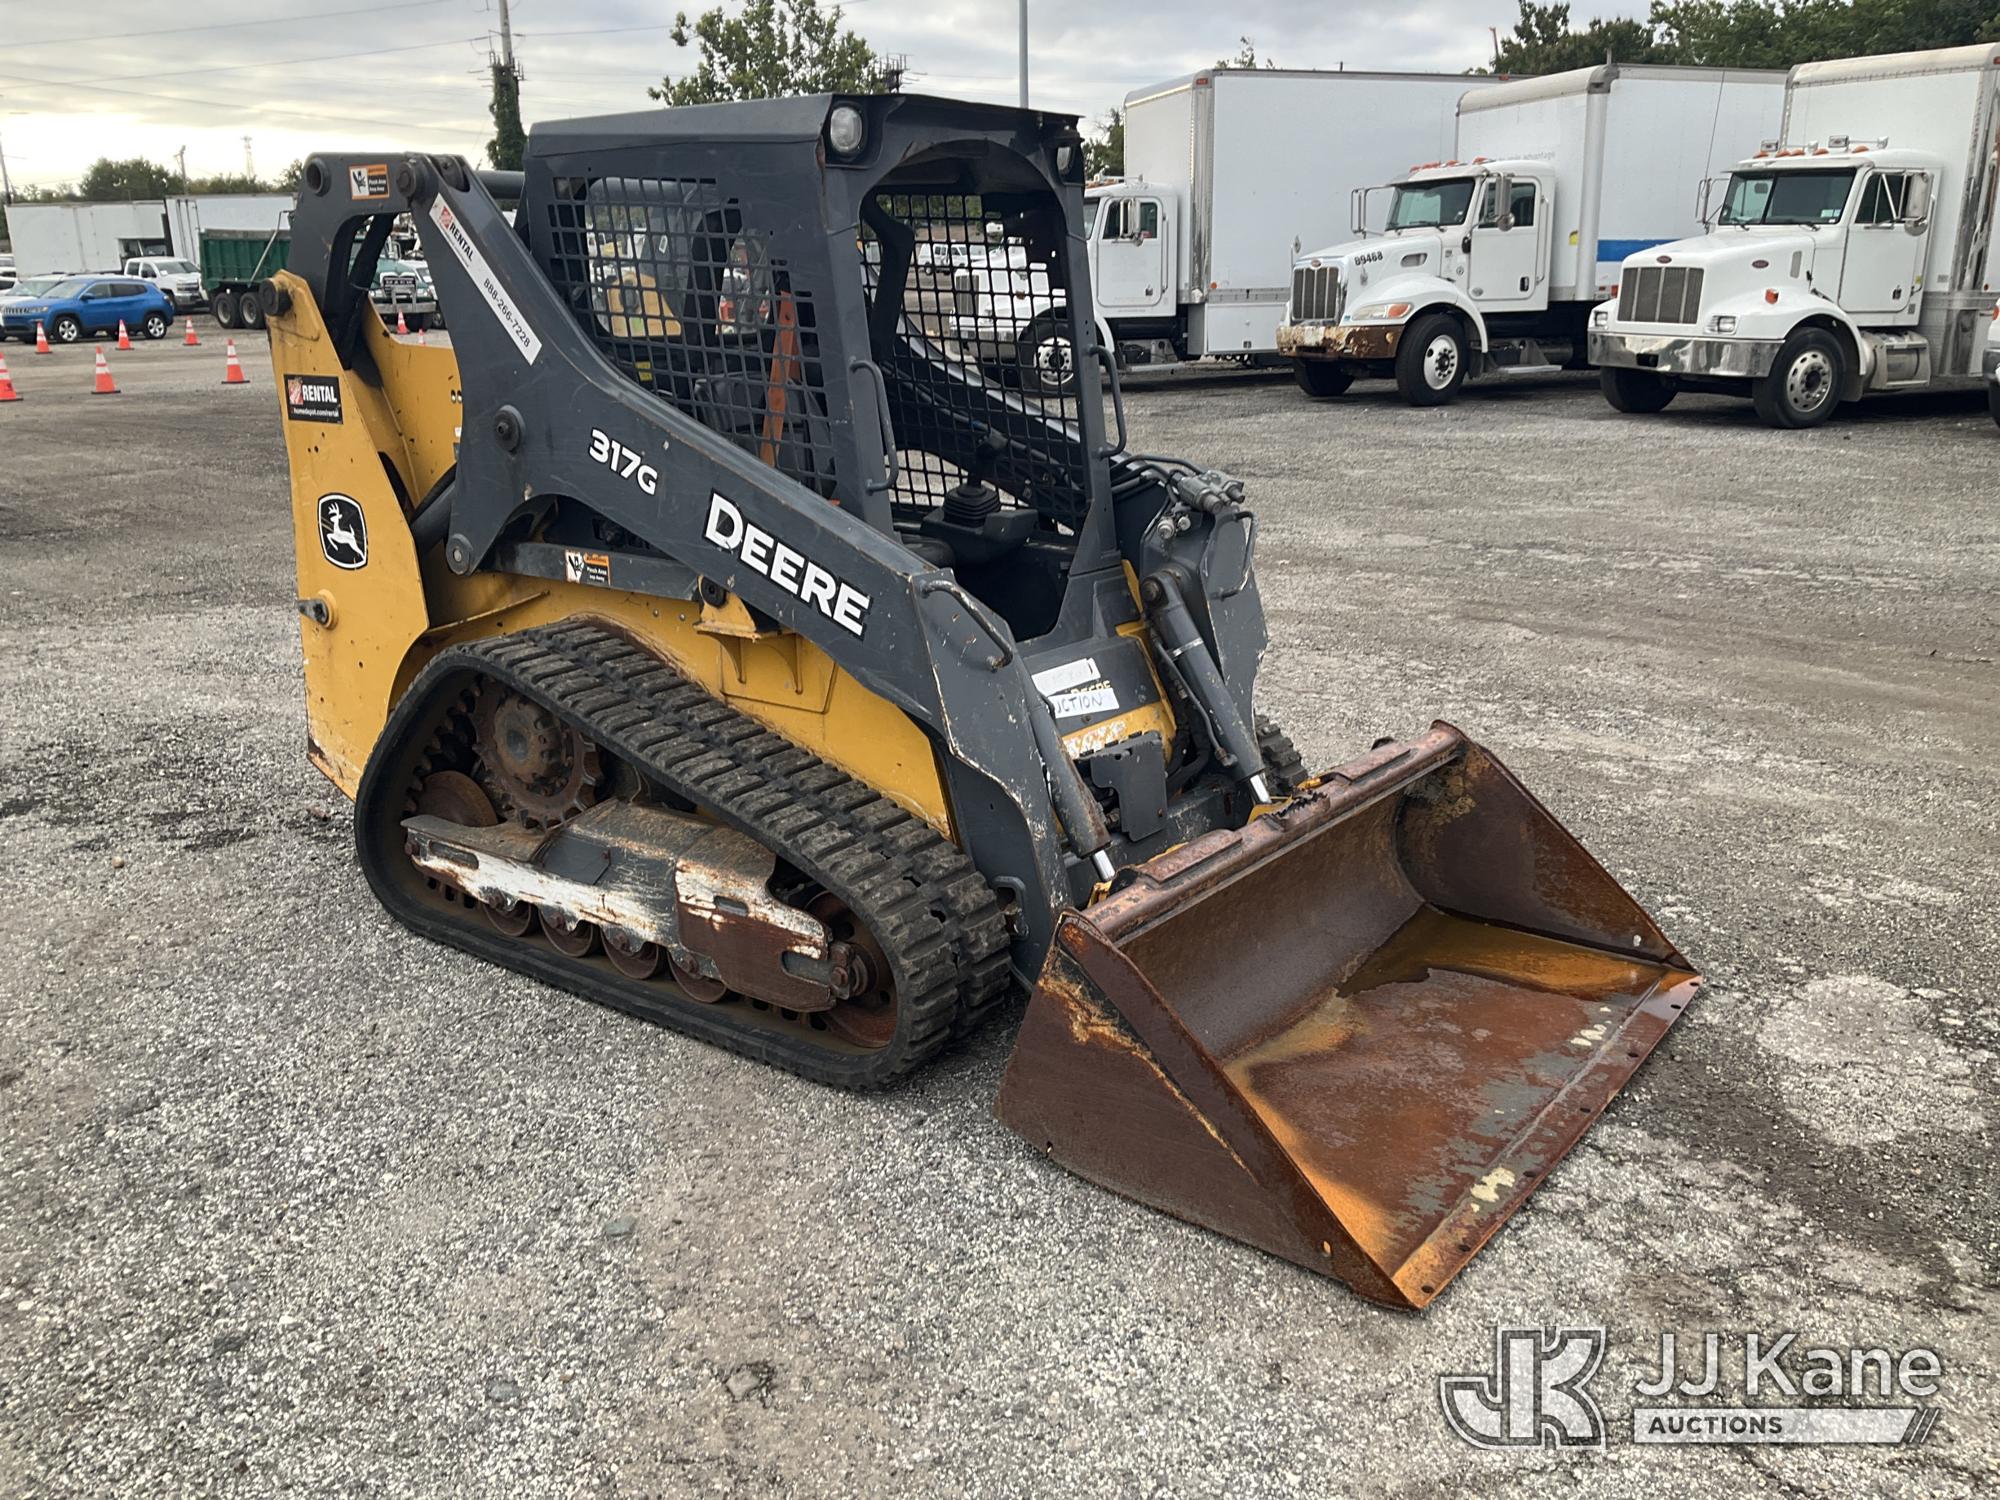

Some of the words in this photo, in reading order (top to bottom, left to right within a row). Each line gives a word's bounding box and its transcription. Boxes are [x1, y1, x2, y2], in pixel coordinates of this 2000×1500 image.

[449, 222, 474, 262] RENTAL
[483, 278, 531, 348] 888-266-7228
[302, 384, 338, 403] RENTAL
[589, 427, 658, 495] 317G
[705, 492, 871, 637] DEERE
